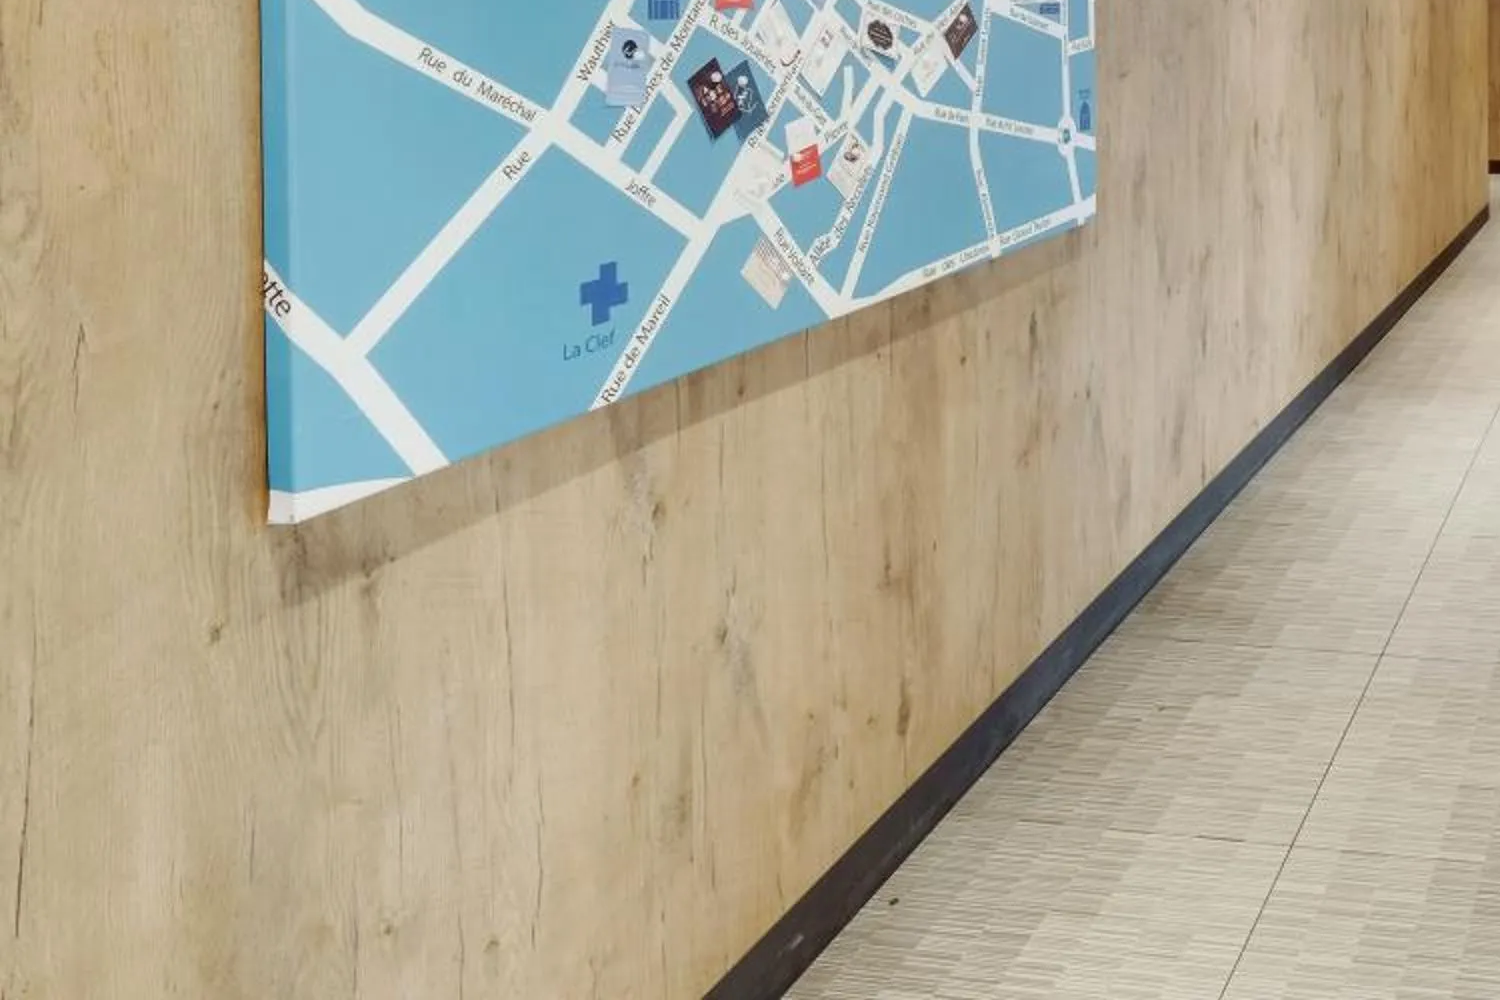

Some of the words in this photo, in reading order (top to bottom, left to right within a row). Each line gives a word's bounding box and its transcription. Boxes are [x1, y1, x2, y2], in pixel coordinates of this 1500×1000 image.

[417, 47, 448, 73] Rue
[453, 69, 473, 89] du
[476, 81, 537, 122] Maréchal
[611, 111, 636, 143] Rue
[502, 150, 531, 182] Rue
[564, 342, 581, 361] La
[585, 328, 617, 353] Clef
[601, 369, 627, 403] Rue
[624, 346, 641, 369] de
[635, 295, 672, 345] Mareil
